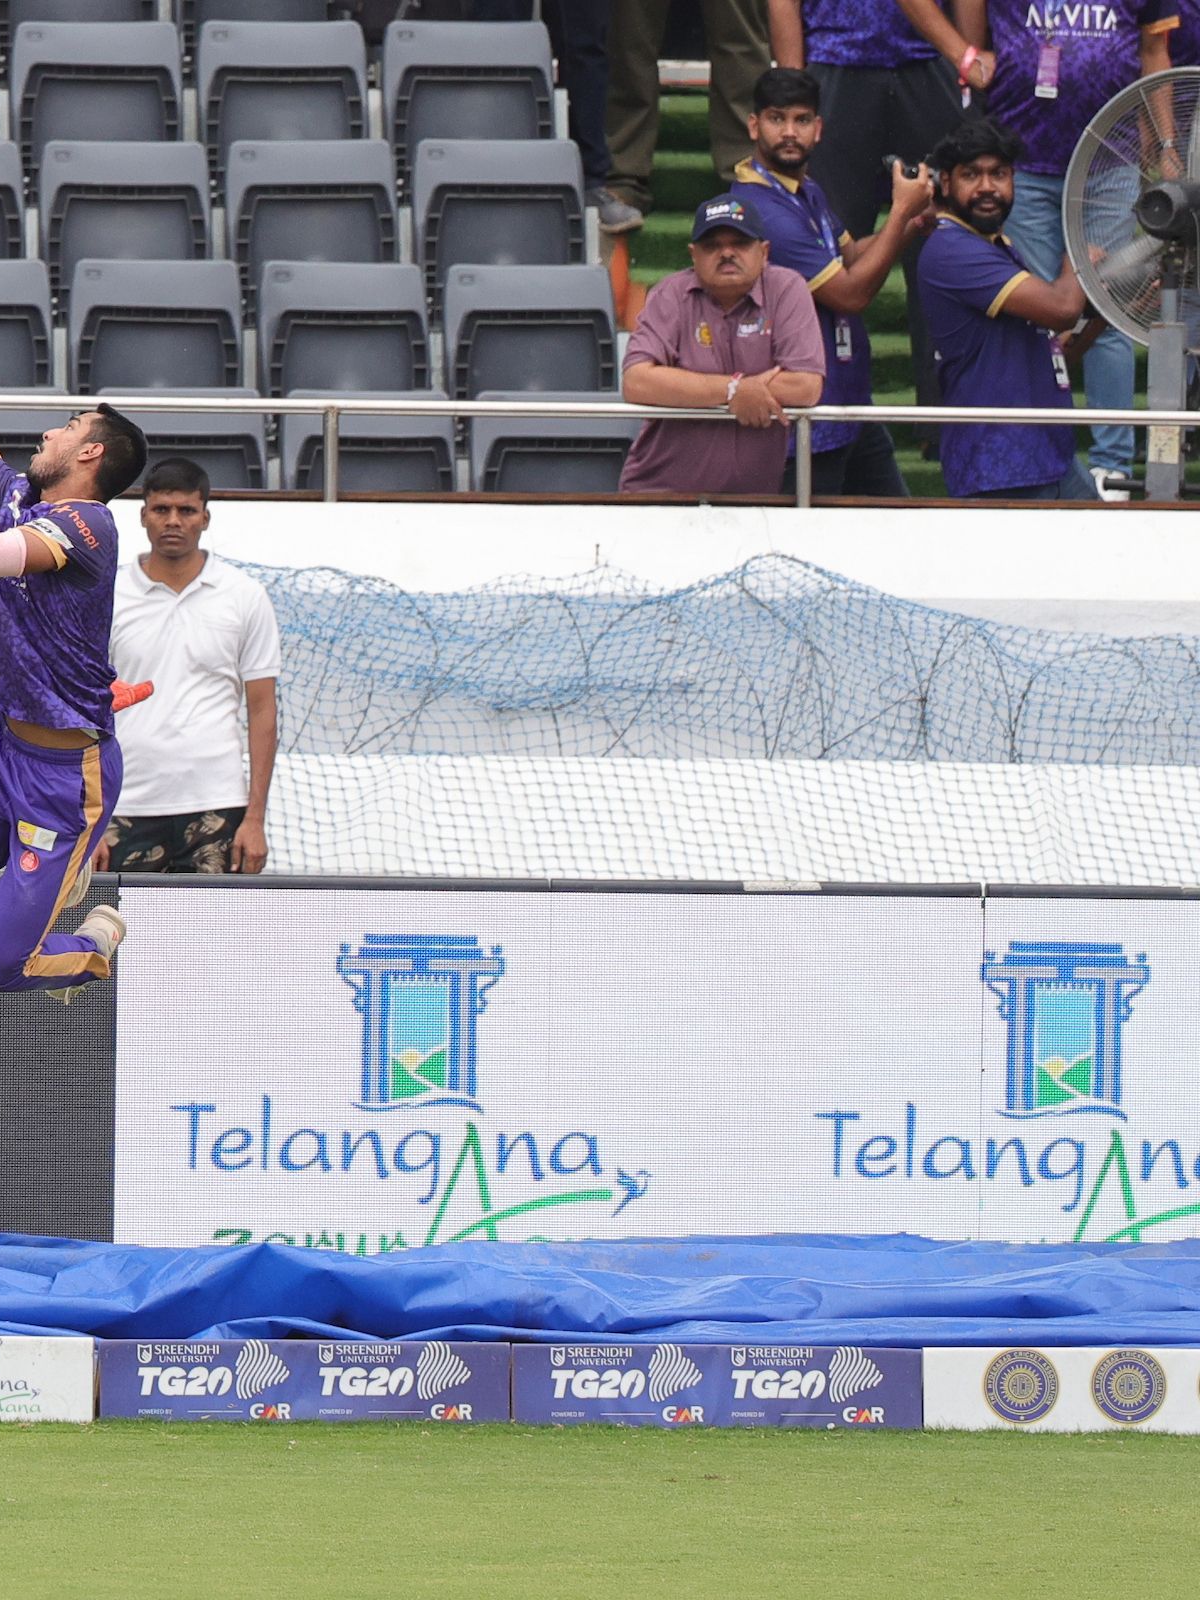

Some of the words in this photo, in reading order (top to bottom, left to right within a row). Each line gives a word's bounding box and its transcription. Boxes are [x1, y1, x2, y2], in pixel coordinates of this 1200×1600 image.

[68, 510, 100, 550] happi
[154, 1344, 220, 1355] SREENIDHI
[336, 1344, 401, 1355] SREENIDHI
[567, 1347, 633, 1358] SREENIDHI
[748, 1347, 813, 1358] SREENIDHI
[158, 1355, 215, 1364] UNIVERSITY
[340, 1355, 396, 1364] UNIVERSITY
[572, 1358, 627, 1366] UNIVERSITY
[752, 1358, 808, 1367] UNIVERSITY
[137, 1366, 233, 1397] TG20
[318, 1366, 415, 1397] TG20
[550, 1369, 646, 1399] TG20
[731, 1369, 826, 1400] TG20
[249, 1402, 291, 1420] GMR
[430, 1403, 473, 1421] GMR
[662, 1405, 704, 1423] GMR
[842, 1406, 885, 1424] GMR
